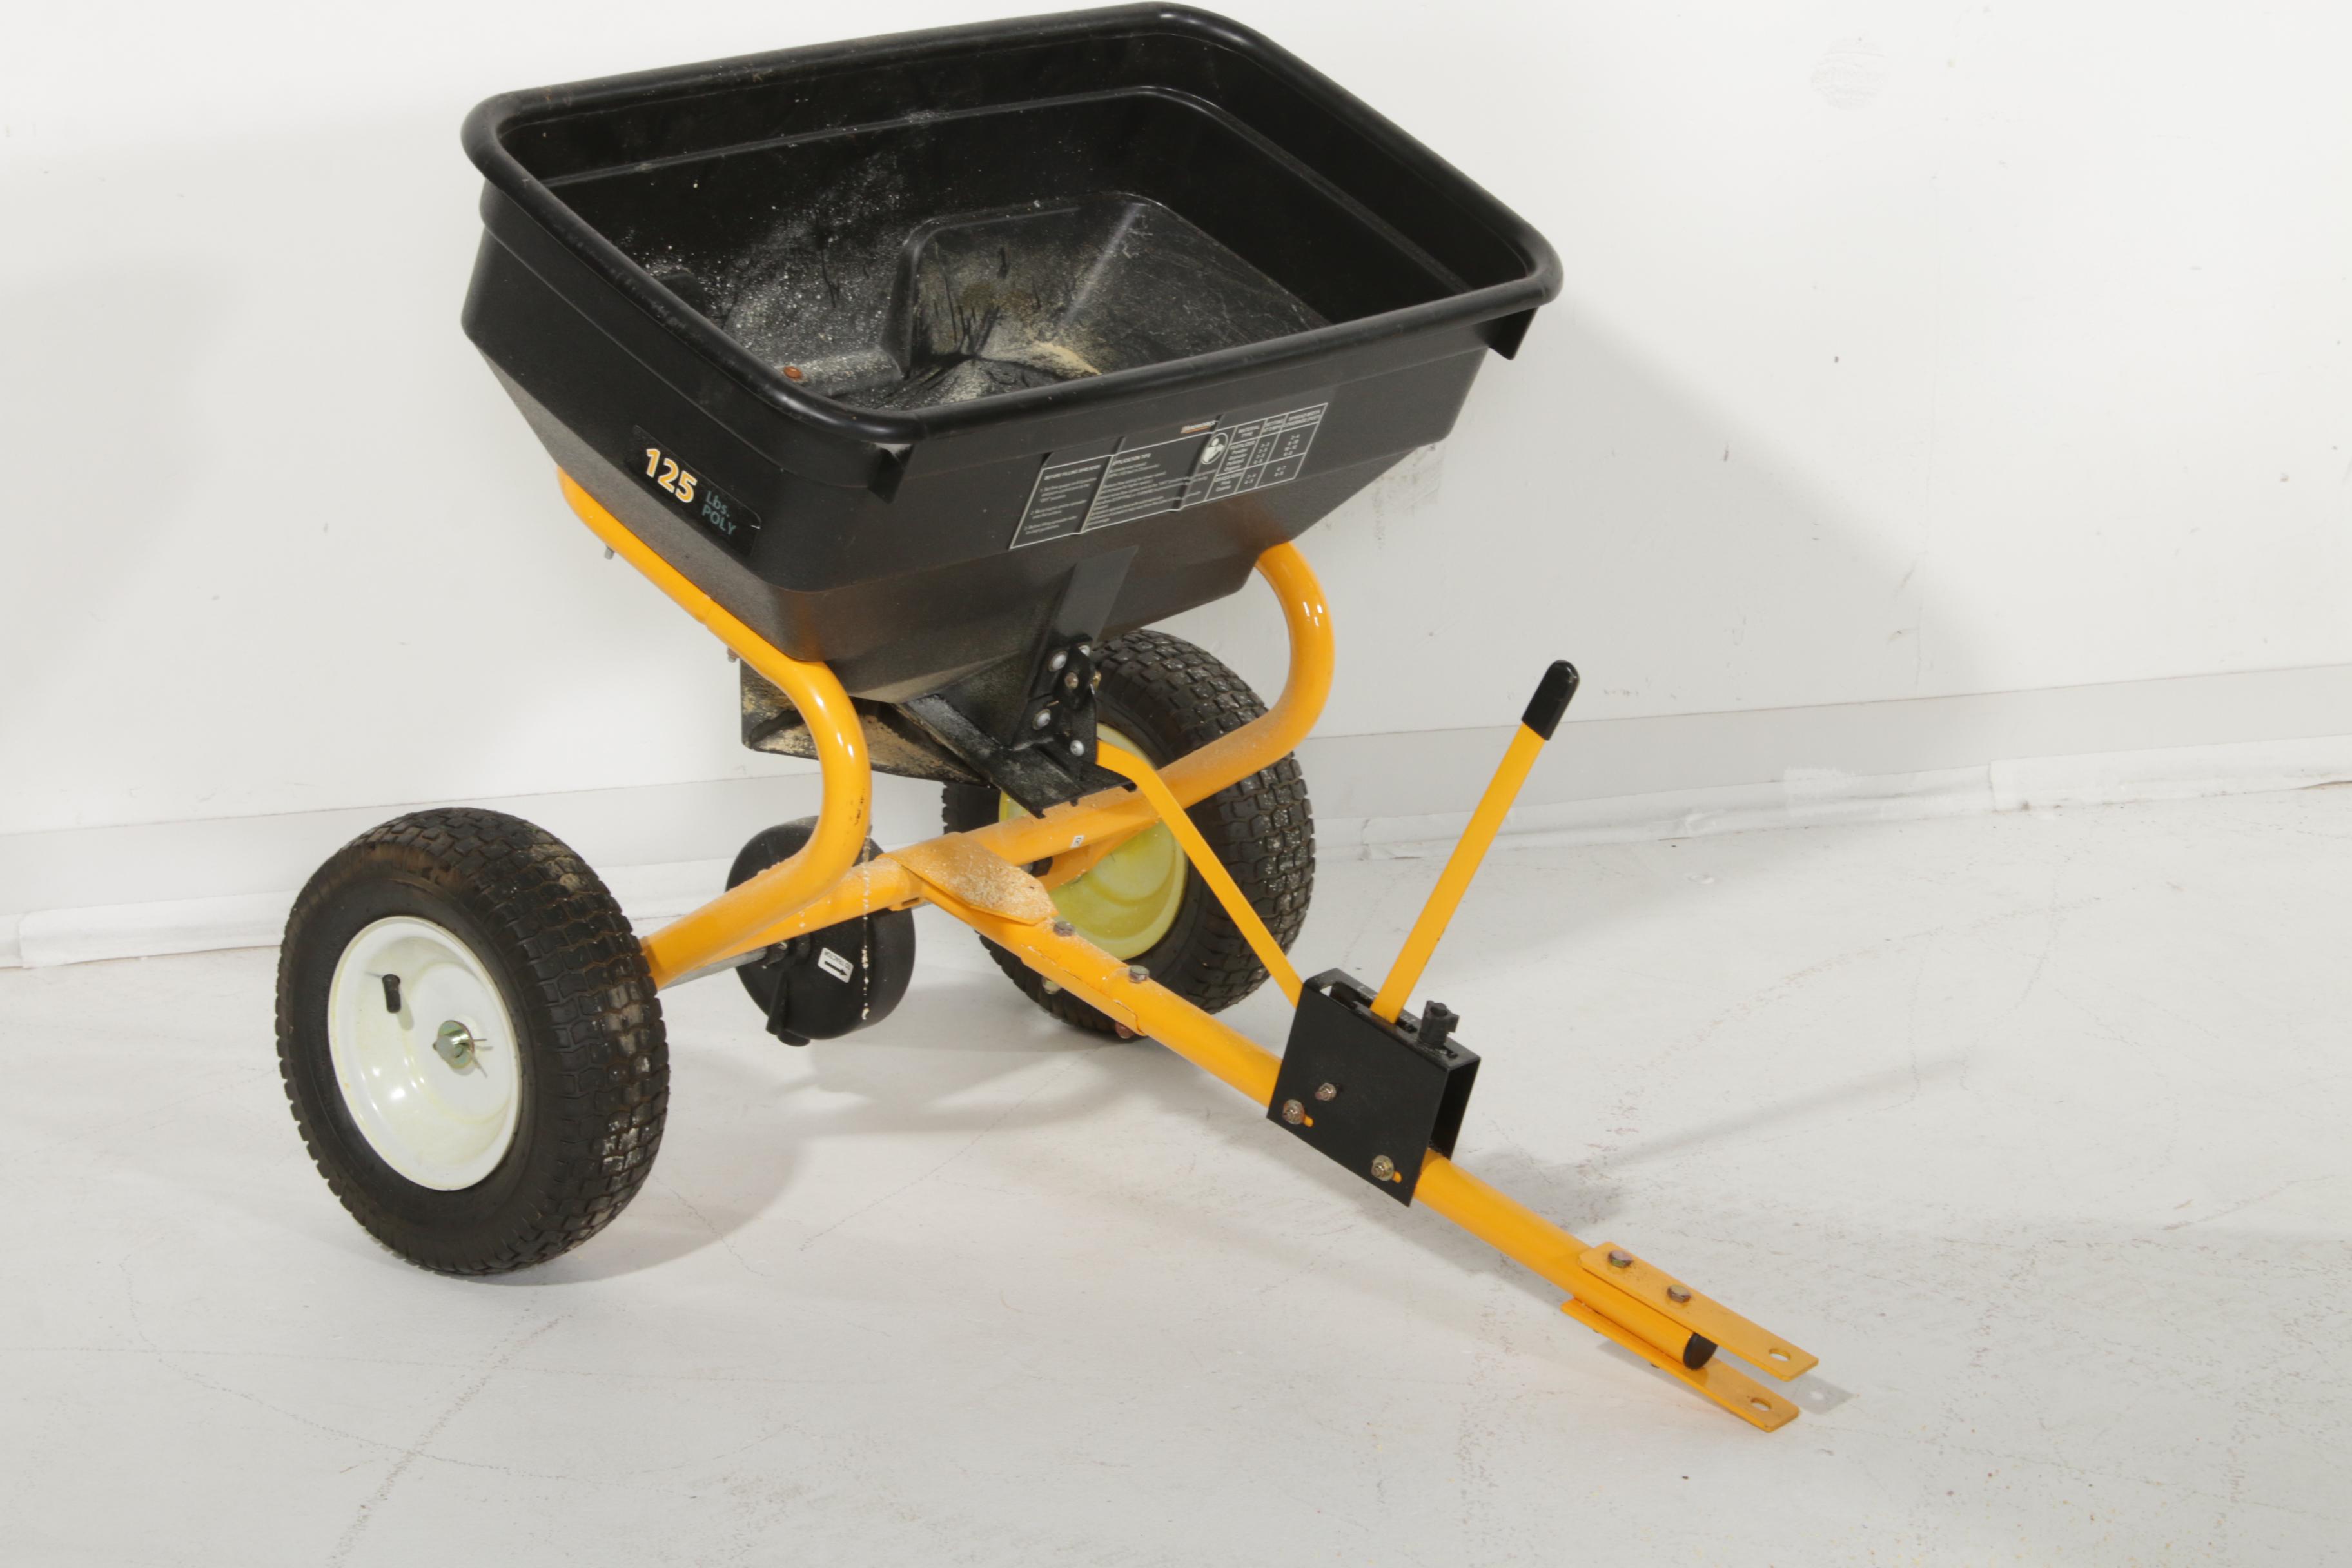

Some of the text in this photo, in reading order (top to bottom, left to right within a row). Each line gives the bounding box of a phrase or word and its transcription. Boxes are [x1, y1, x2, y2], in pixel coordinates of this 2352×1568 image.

[646, 448, 698, 503] 125
[701, 504, 736, 535] POLY
[705, 491, 730, 518] Lbs.
